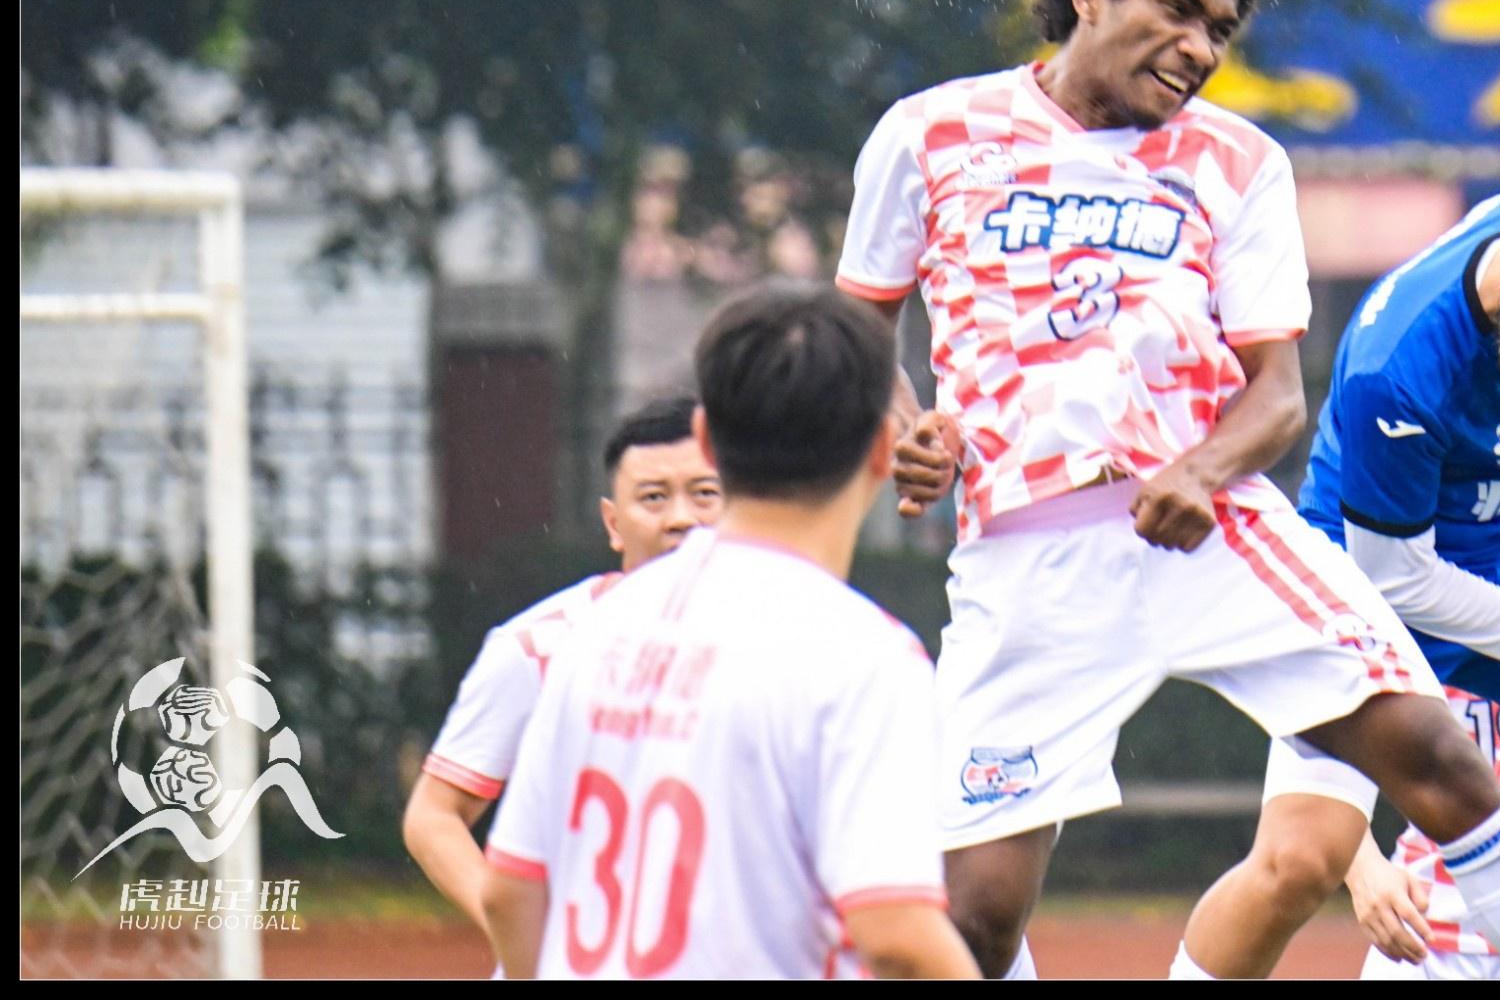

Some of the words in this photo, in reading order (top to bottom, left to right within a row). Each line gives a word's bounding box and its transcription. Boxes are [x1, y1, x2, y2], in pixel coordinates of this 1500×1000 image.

[984, 191, 1186, 259] 卡纳德
[1048, 257, 1124, 341] 3
[564, 768, 706, 980] 30
